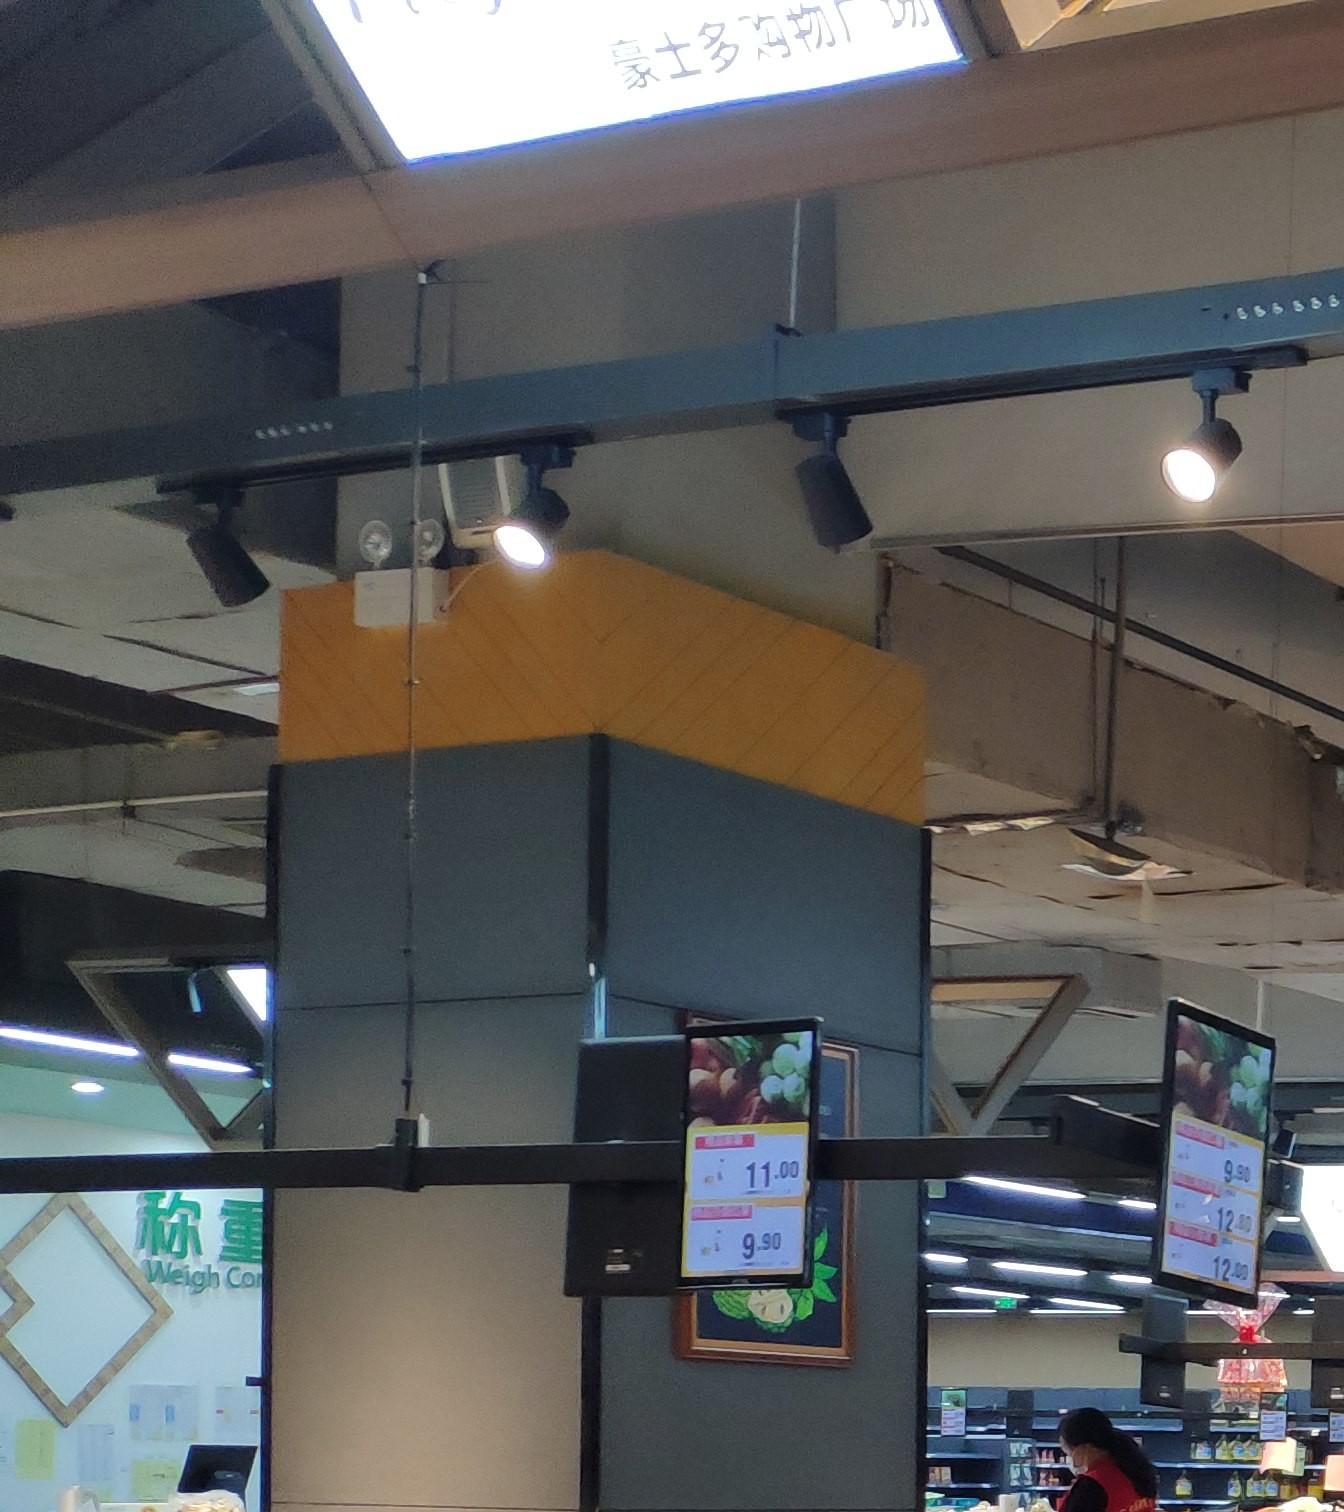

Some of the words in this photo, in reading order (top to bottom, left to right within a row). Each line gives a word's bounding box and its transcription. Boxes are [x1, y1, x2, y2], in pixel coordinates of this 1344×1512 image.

[746, 1161, 799, 1188] 11.00
[742, 1232, 781, 1259] 9.90
[143, 1260, 220, 1295] Weigh
